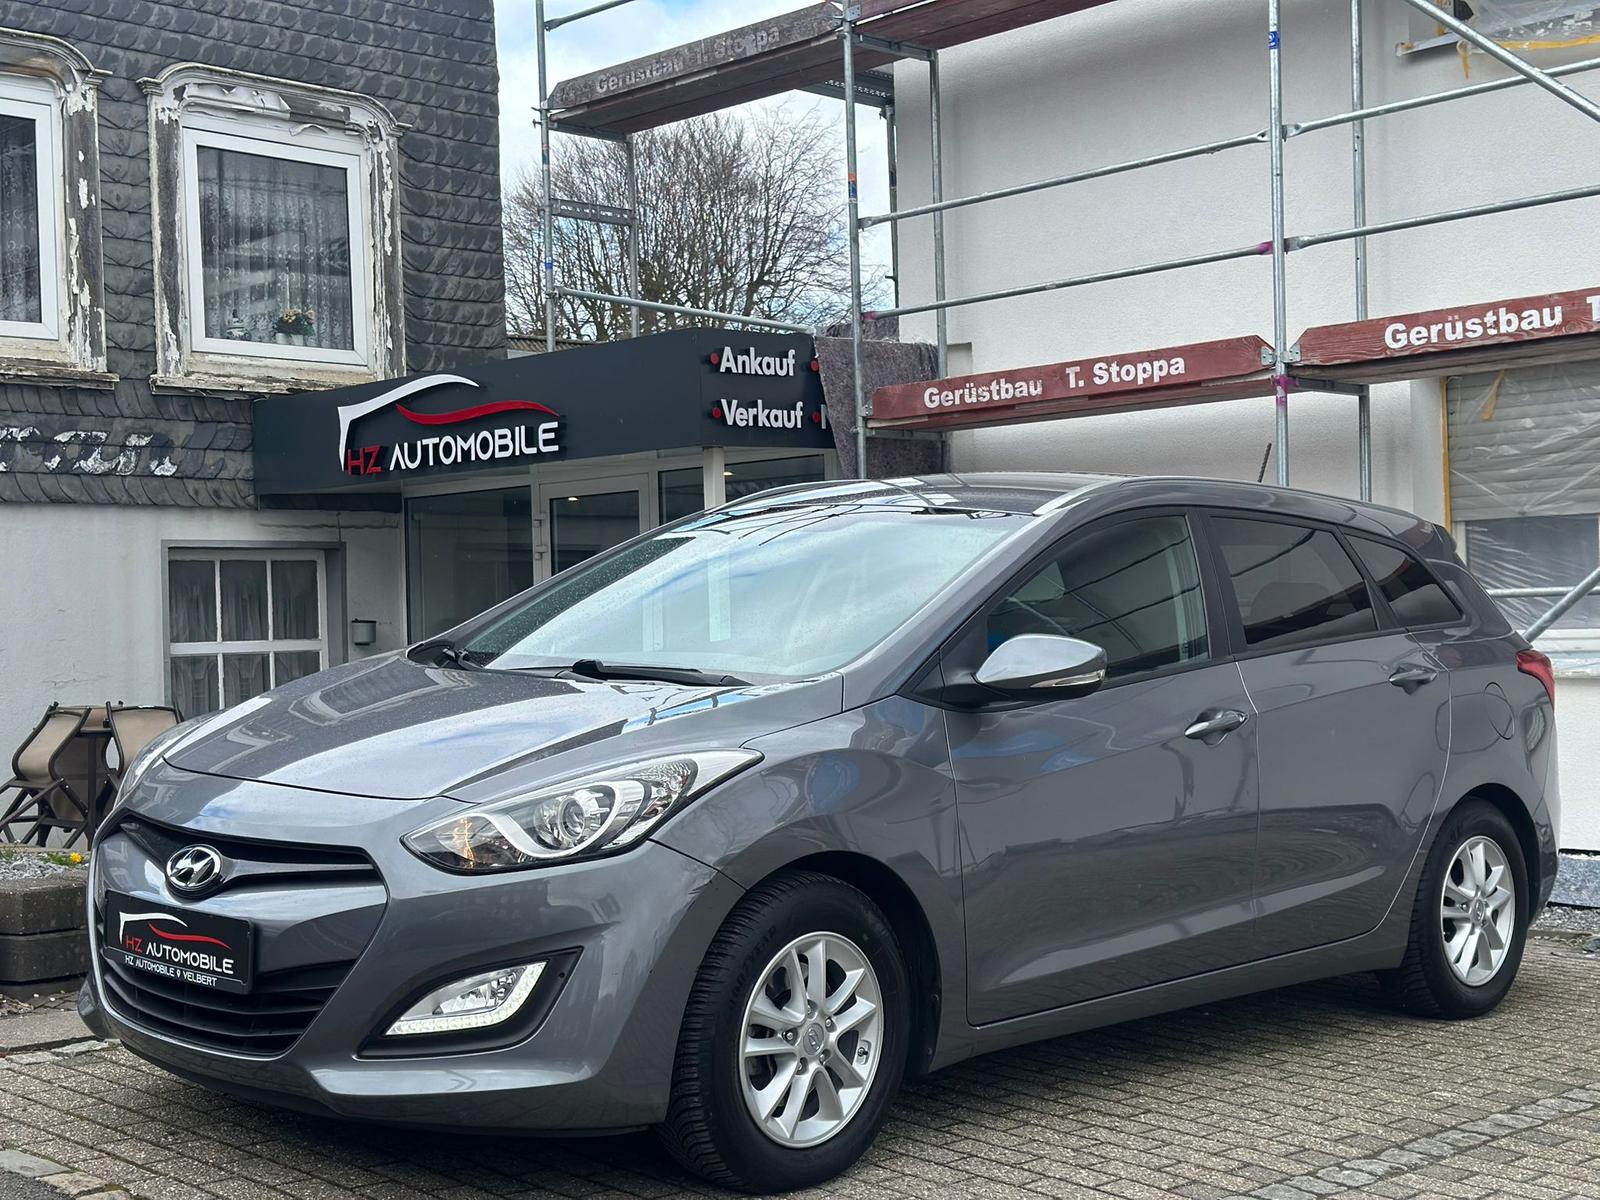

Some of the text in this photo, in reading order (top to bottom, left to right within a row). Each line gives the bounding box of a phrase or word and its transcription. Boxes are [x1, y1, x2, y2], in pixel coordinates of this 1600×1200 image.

[1384, 306, 1563, 349] Gerüstbau
[719, 346, 796, 377] Ankauf
[923, 356, 1186, 409] Gerüstbau T. Stoppa
[720, 398, 804, 429] Verkauf
[347, 420, 559, 476] HZ AUTOMOBILE
[125, 955, 217, 987] HZ AUTOMOBILE VELBERT
[126, 935, 234, 974] HZ AUTOMOBILE
